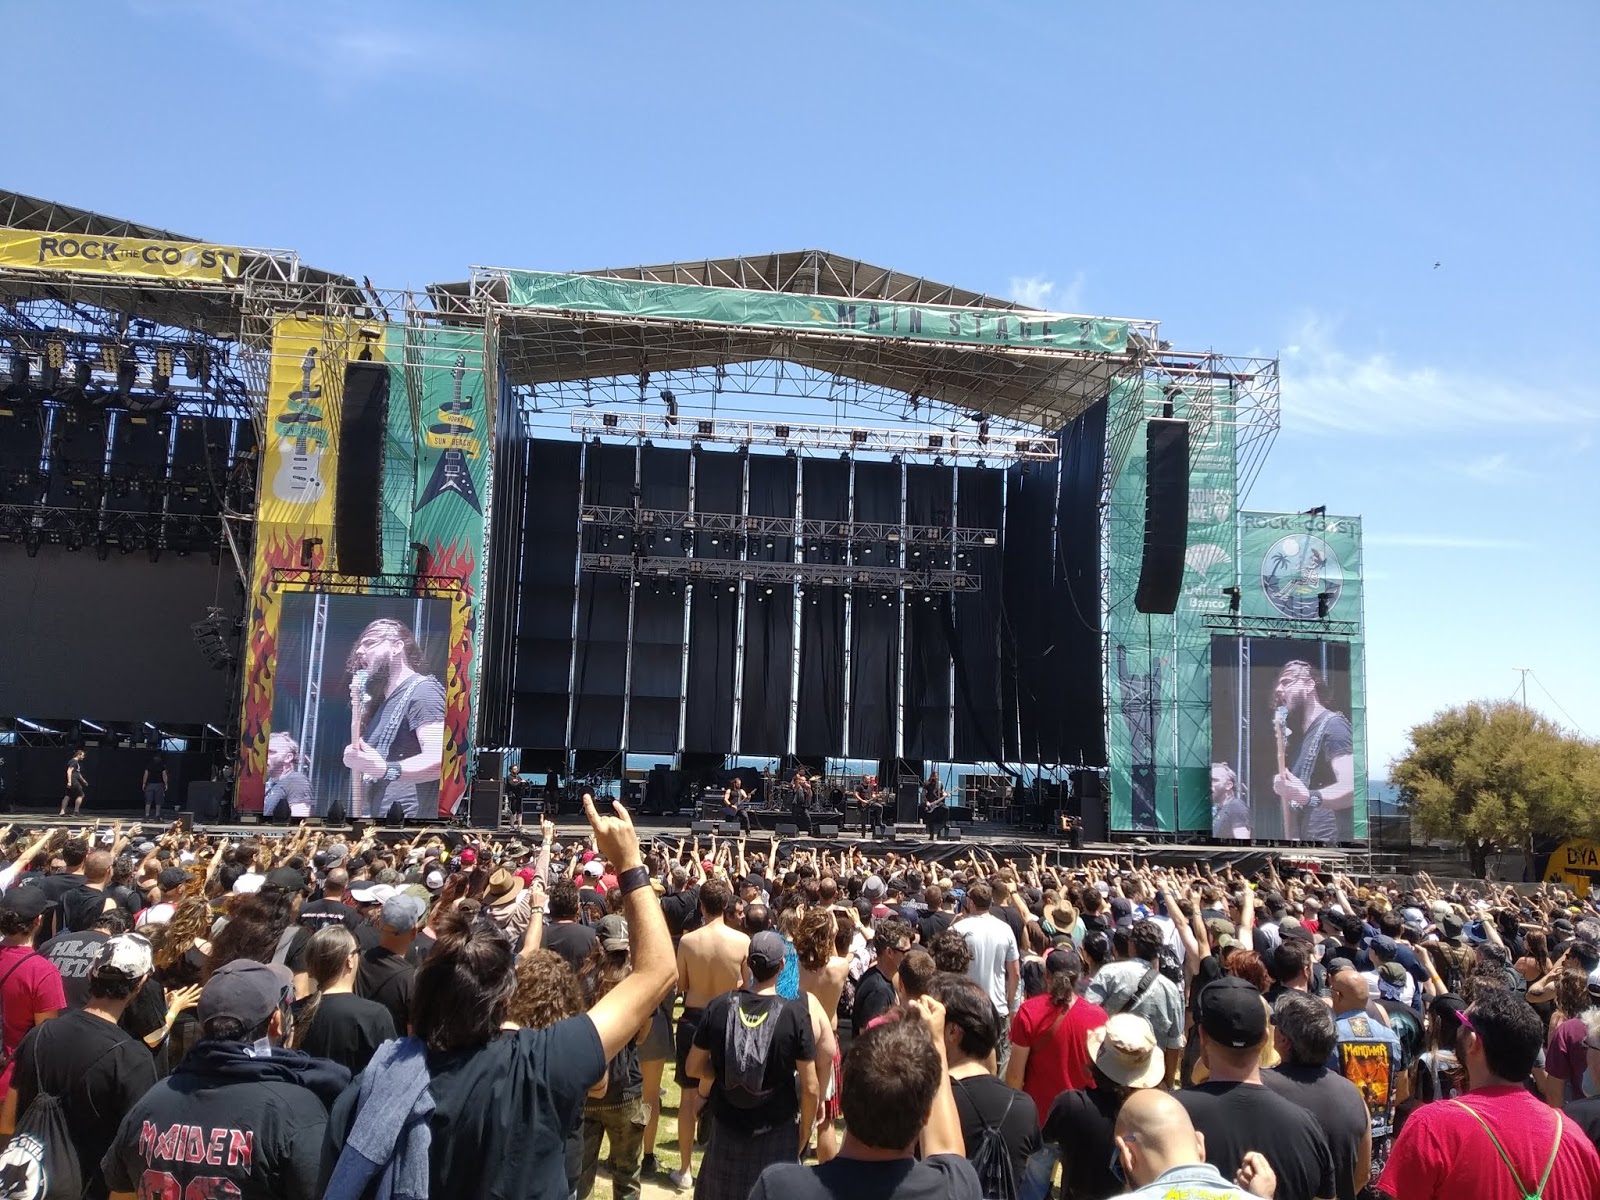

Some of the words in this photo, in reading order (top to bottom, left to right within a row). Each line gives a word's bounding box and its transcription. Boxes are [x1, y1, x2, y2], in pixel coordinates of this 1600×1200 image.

[39, 237, 119, 262] ROCK
[120, 248, 140, 259] THE
[838, 302, 922, 334] MAIN
[949, 312, 1053, 343] STAGE
[1078, 320, 1093, 346] 2
[434, 437, 446, 445] SUN
[451, 438, 471, 447] BEACH
[1189, 488, 1232, 503] ADNESS
[1245, 516, 1293, 533] ROCK
[1184, 584, 1223, 596] Unicaj
[1189, 597, 1225, 608] Banco
[1343, 1043, 1388, 1063] MANOWAR
[139, 1120, 254, 1176] MAIDEN
